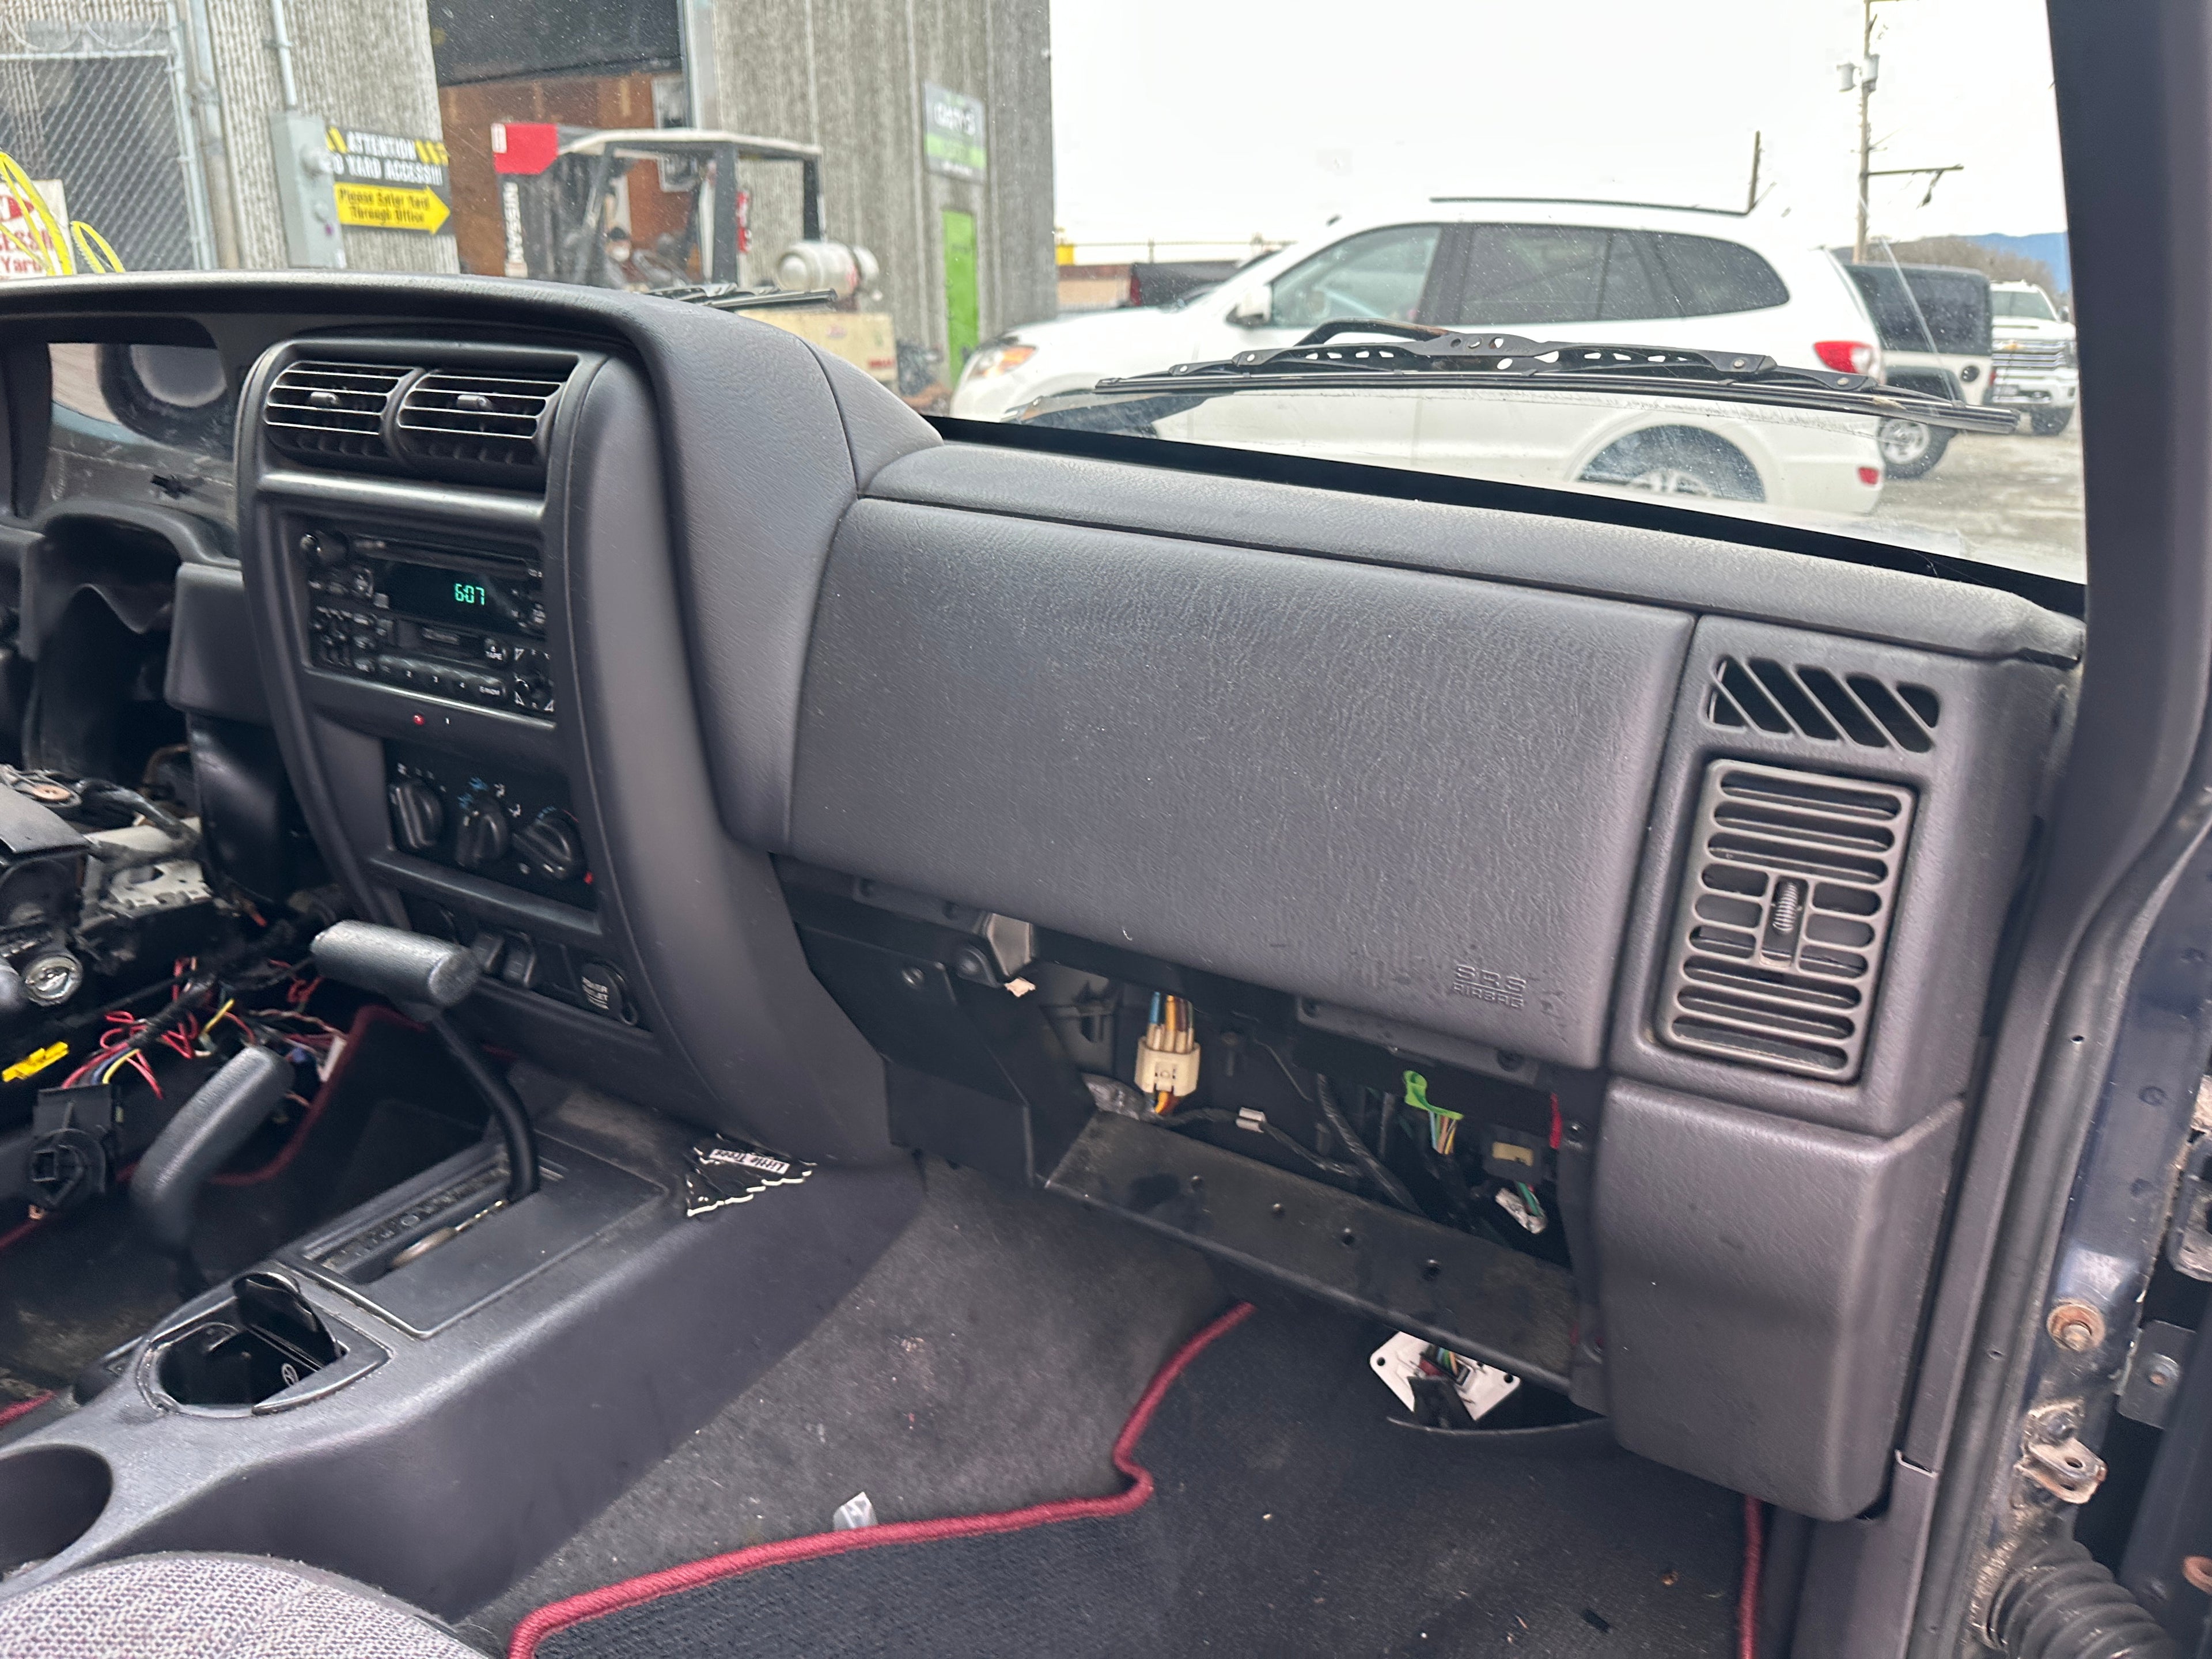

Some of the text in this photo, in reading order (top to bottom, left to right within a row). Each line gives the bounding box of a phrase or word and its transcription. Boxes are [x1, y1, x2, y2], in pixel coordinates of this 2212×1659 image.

[346, 131, 417, 161] ATTENTION
[346, 154, 381, 179] YARD
[339, 187, 430, 210] Please Enter Yard
[350, 206, 425, 225] Through Office
[1455, 964, 1527, 992] SRS
[1452, 982, 1525, 1010] AIRBAG
[751, 1157, 785, 1172] Little
